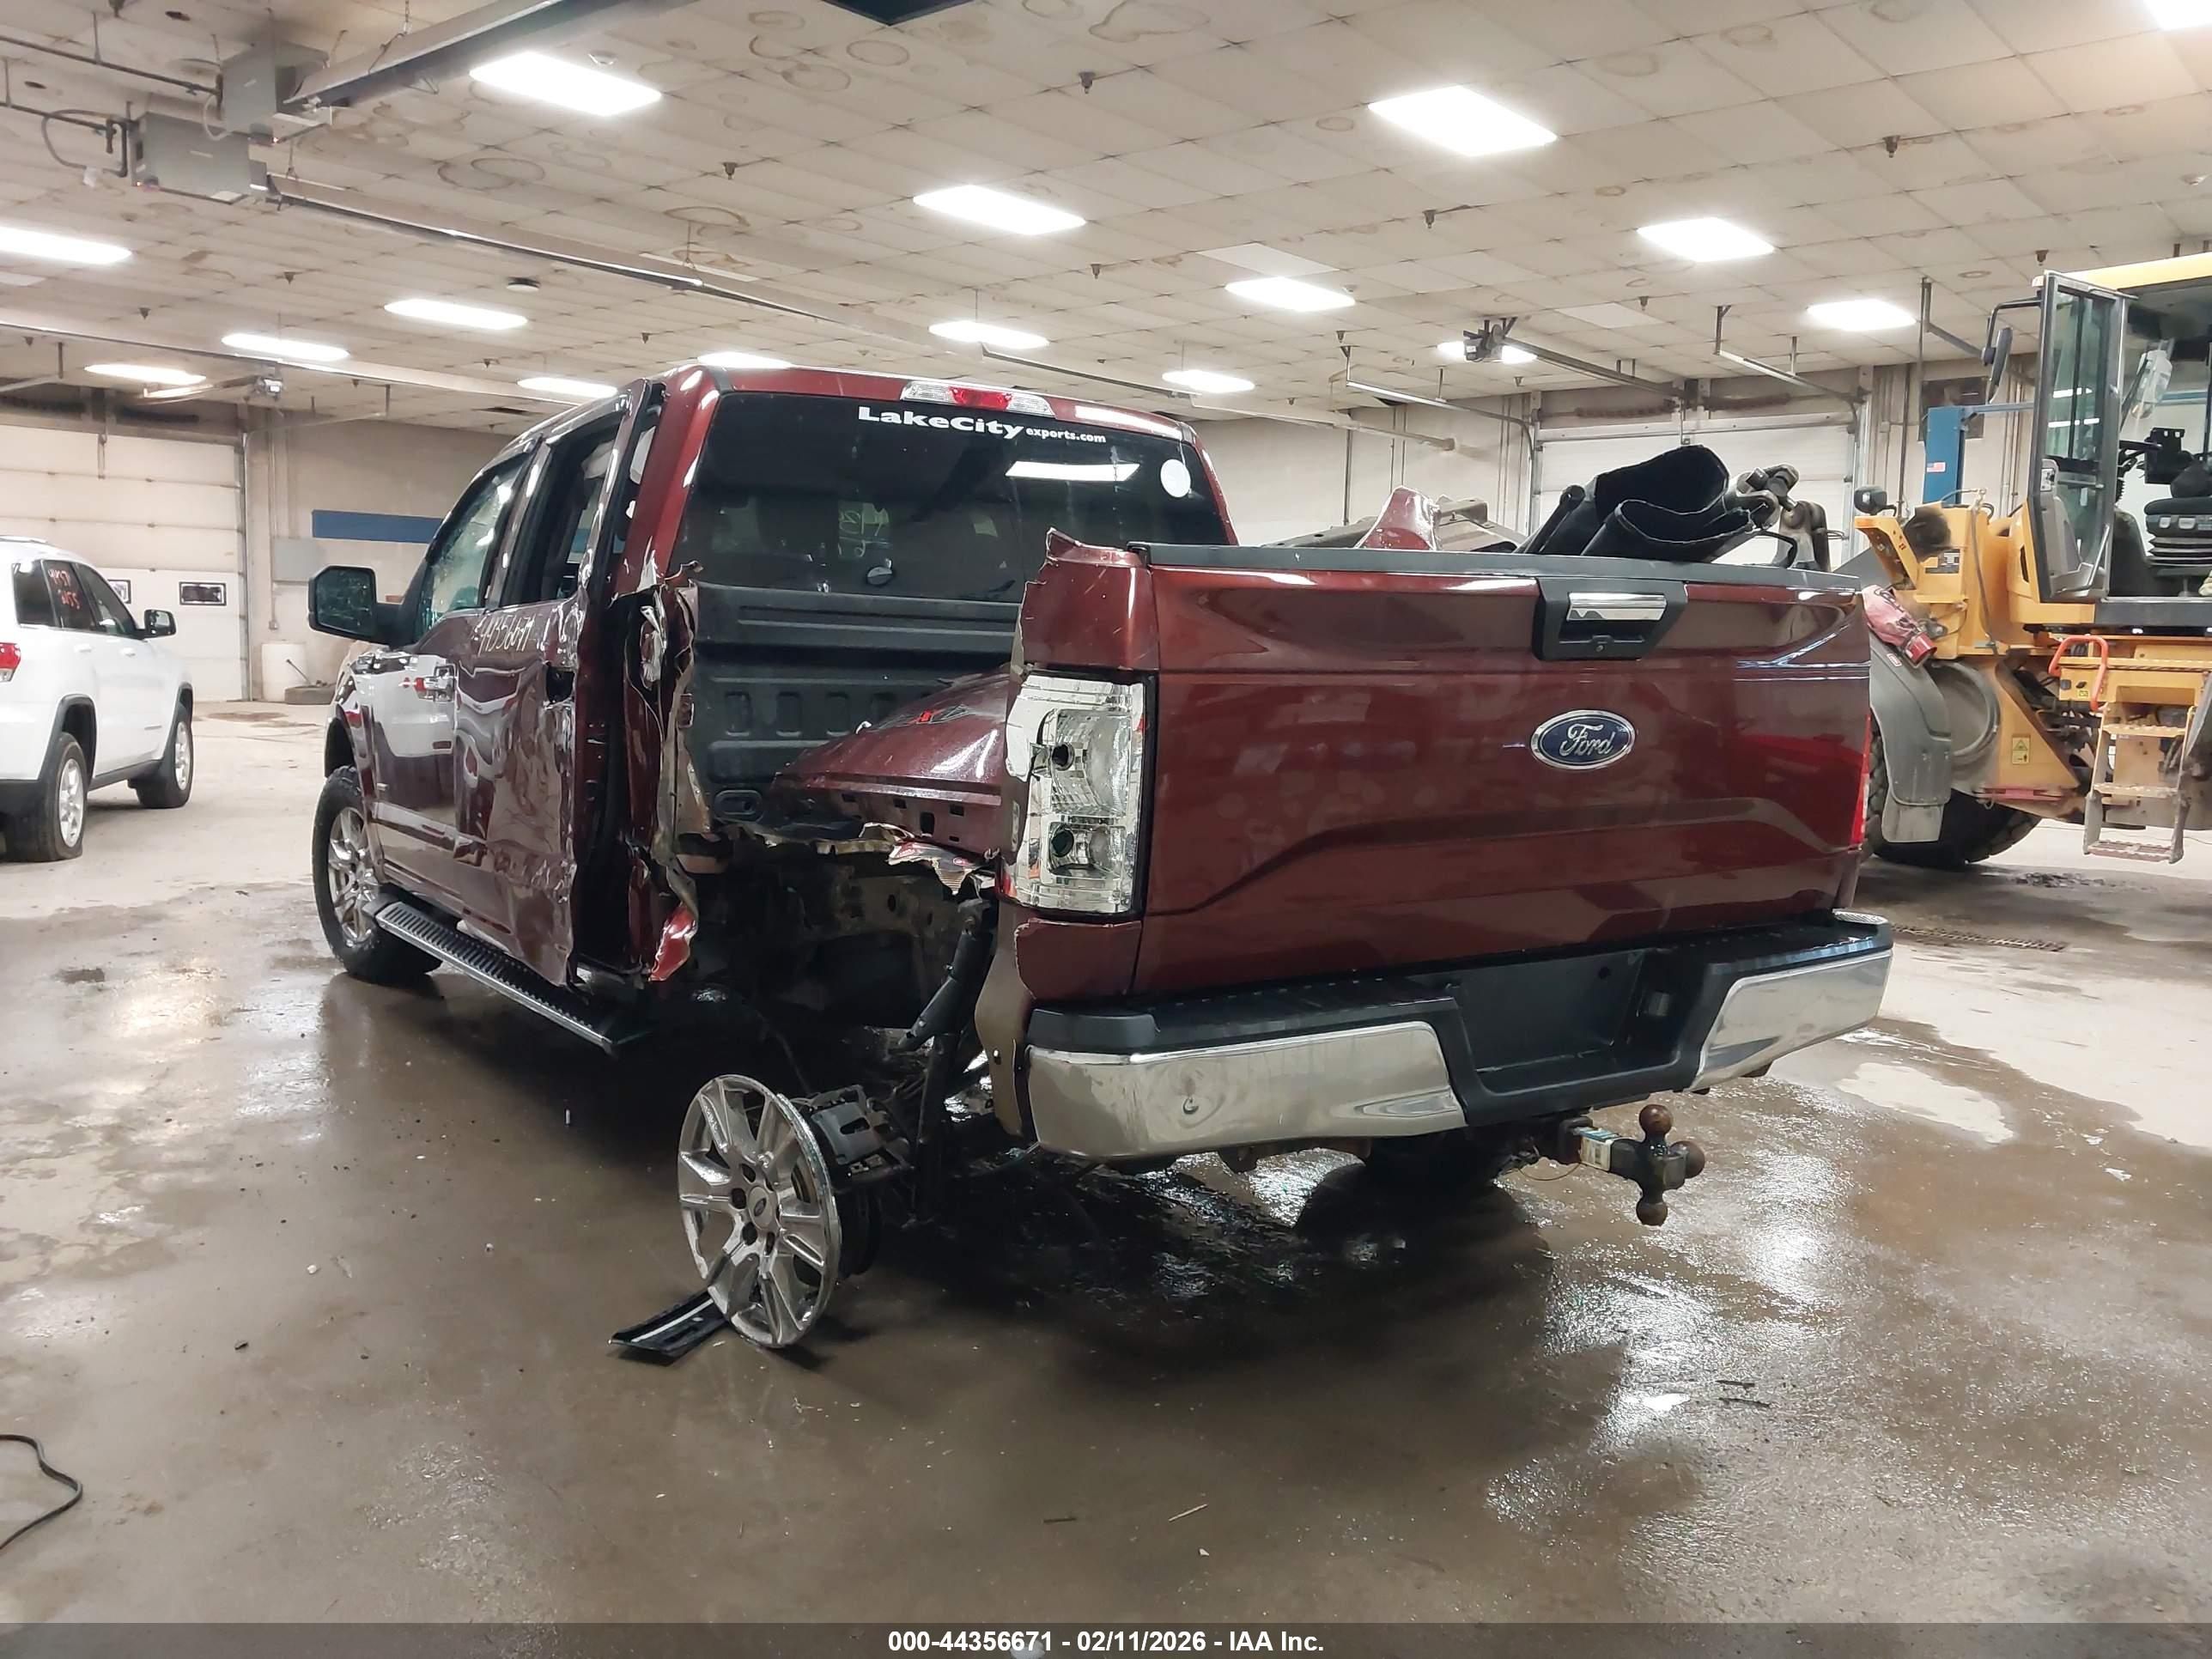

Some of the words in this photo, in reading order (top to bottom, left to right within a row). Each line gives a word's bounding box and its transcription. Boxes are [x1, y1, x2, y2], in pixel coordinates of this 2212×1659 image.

[858, 406, 1024, 440] LakeCity
[1025, 428, 1107, 443] exports.com
[1559, 723, 1616, 757] Ford
